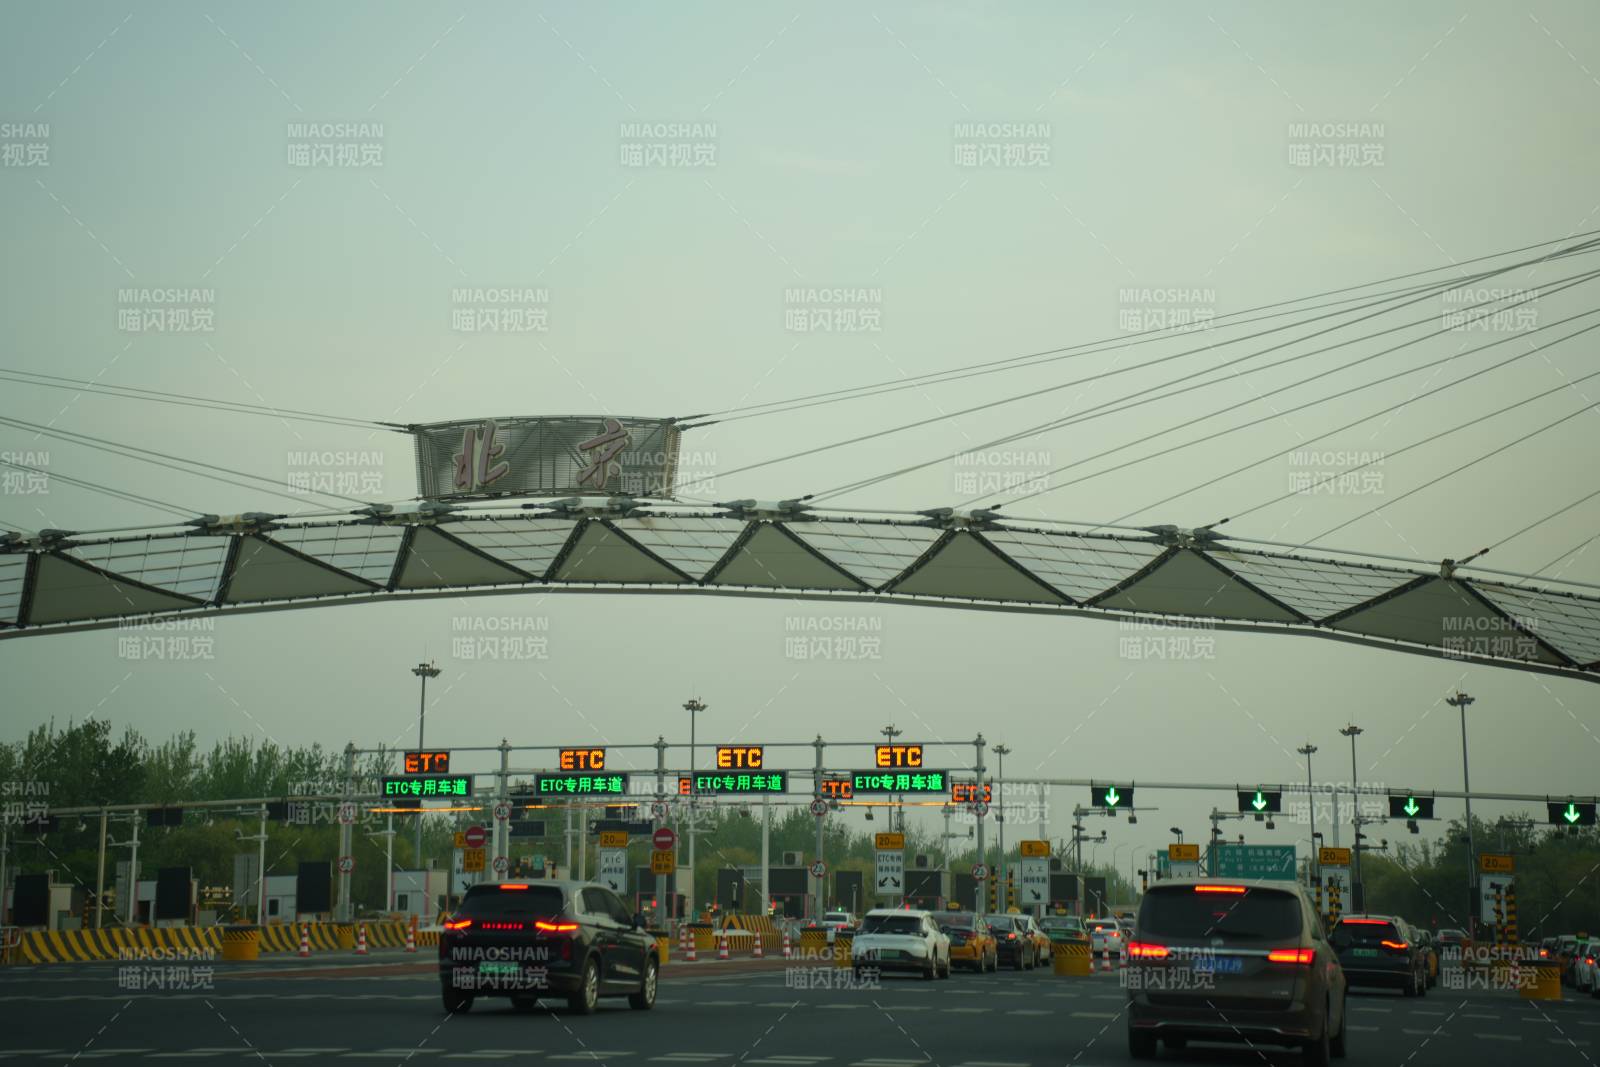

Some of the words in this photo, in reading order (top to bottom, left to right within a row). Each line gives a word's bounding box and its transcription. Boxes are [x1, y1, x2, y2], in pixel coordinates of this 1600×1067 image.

[453, 418, 632, 491] 北京
[405, 753, 448, 773] ETC
[560, 750, 604, 769] ETC
[717, 748, 761, 767] ETC
[876, 747, 921, 767] ETC
[386, 780, 467, 796] ETC专用车道
[541, 777, 623, 792] ETC专用车道
[698, 775, 782, 790] ETC专用车道
[855, 774, 943, 790] ETC专用车道
[603, 834, 615, 844] 20
[879, 837, 889, 846] 20
[1323, 851, 1336, 860] 20
[1485, 858, 1498, 868] 20
[1028, 865, 1044, 873] 人工
